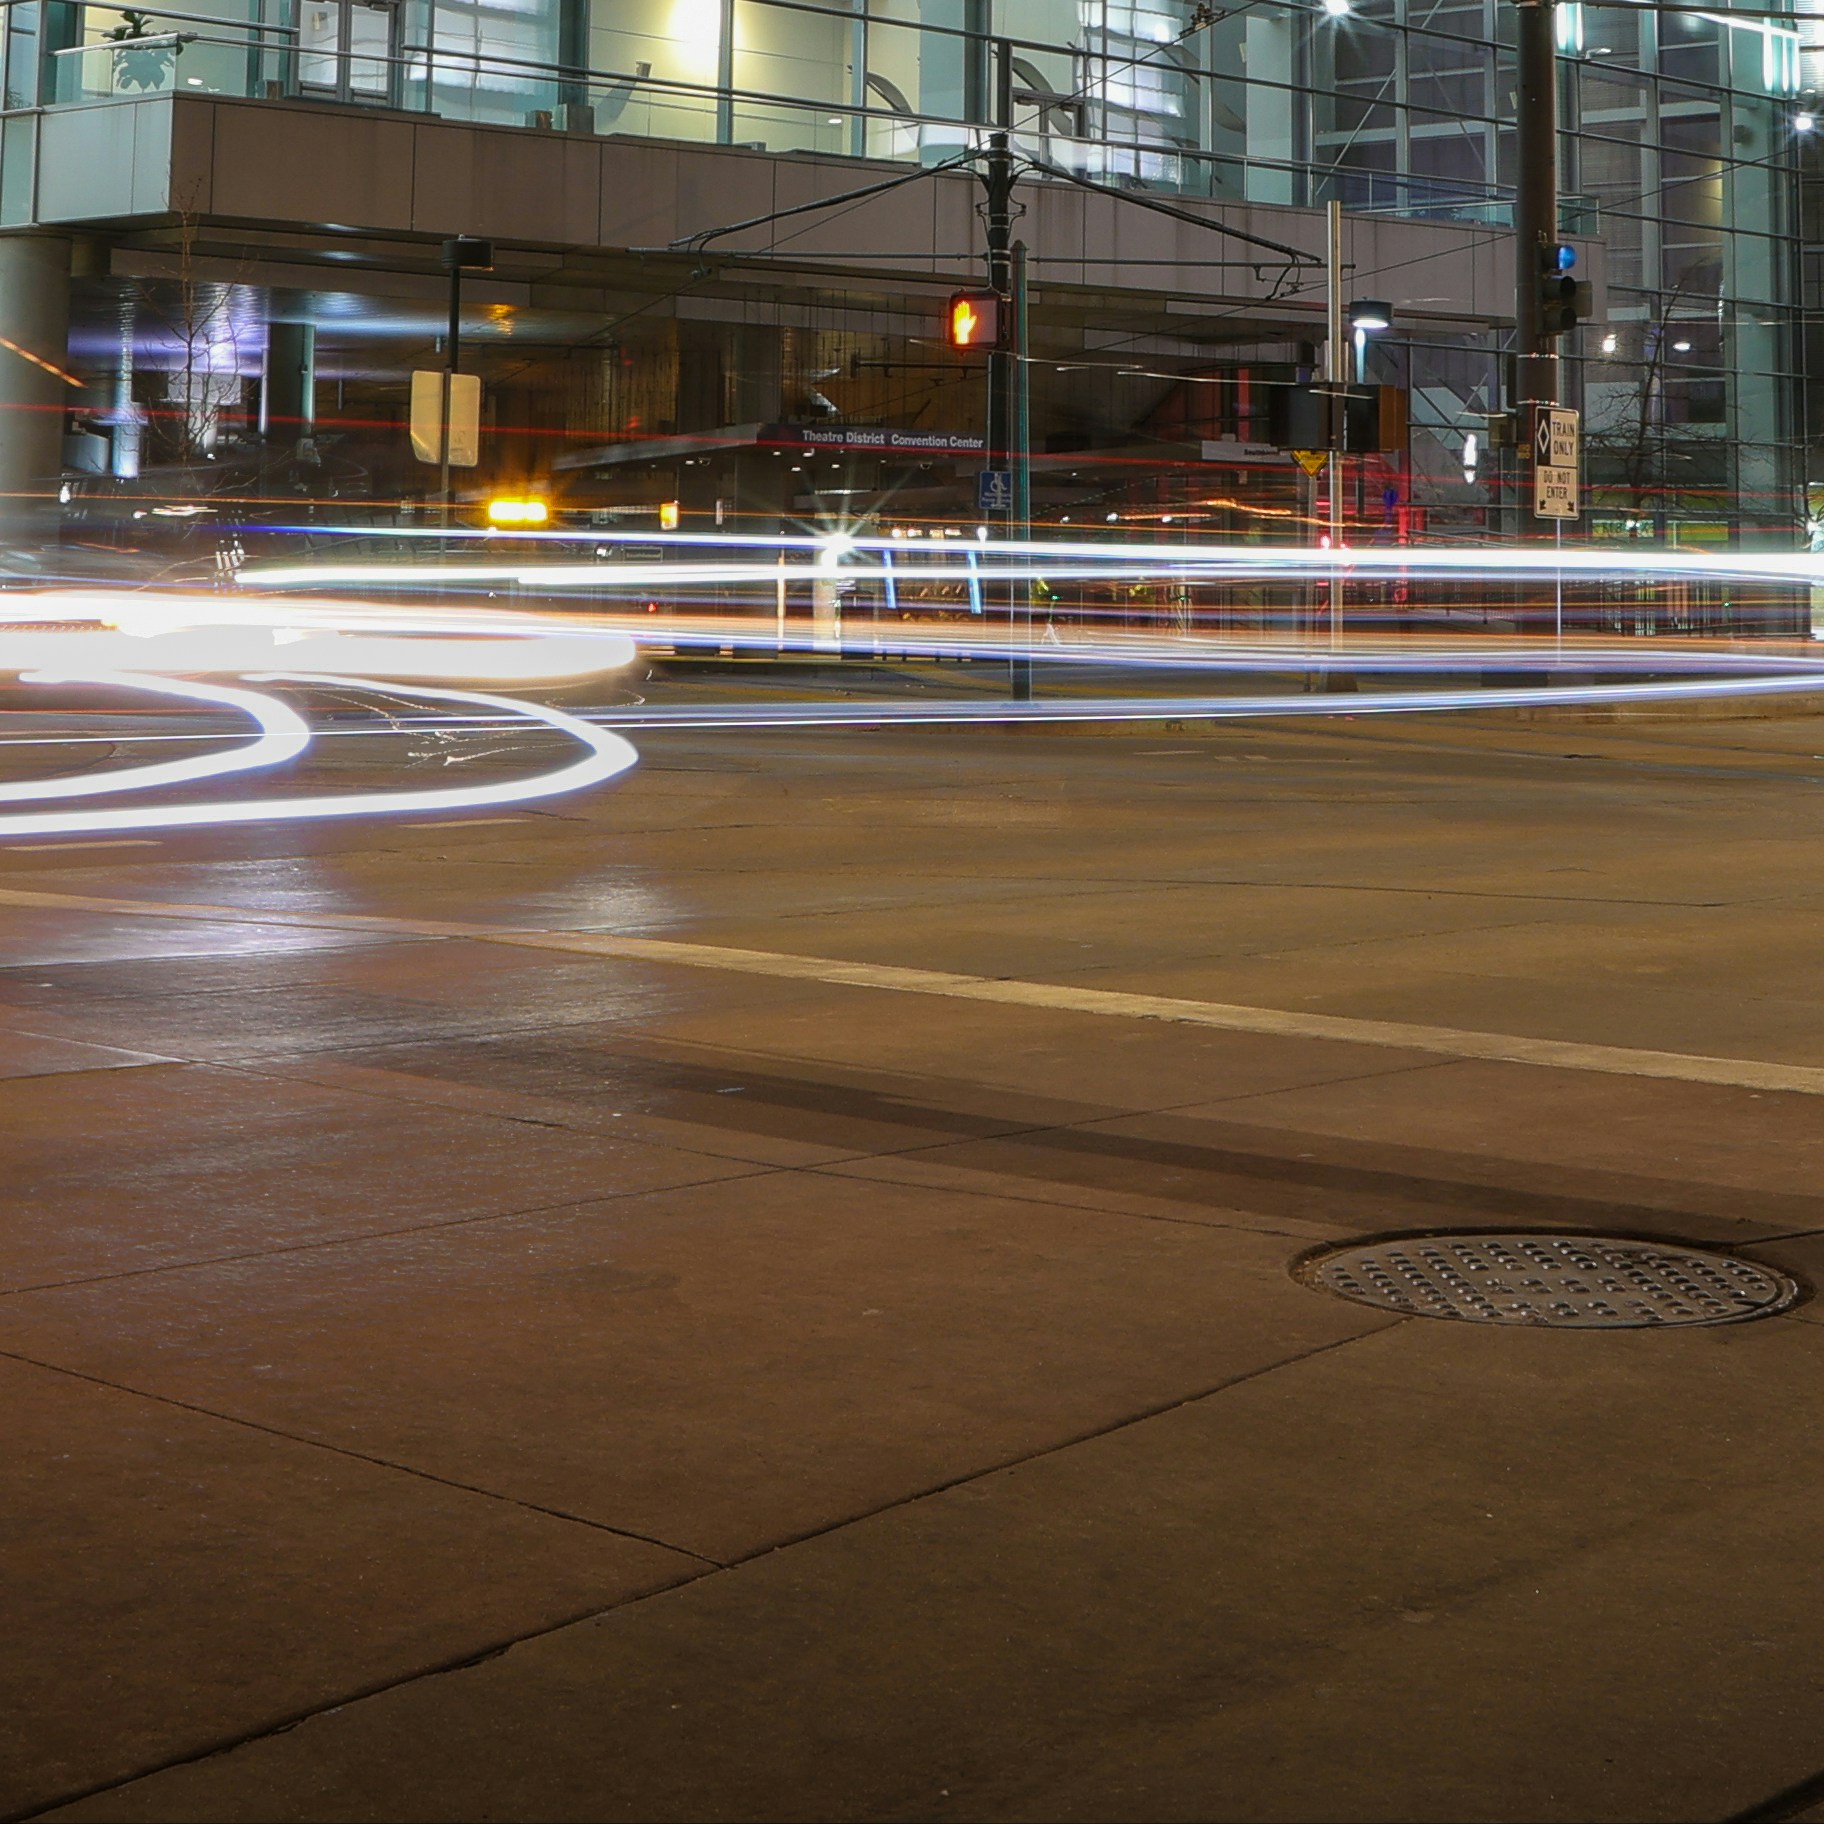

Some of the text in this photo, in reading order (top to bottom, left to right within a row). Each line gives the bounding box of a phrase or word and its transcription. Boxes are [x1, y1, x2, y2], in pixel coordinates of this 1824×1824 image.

[1552, 421, 1575, 437] TRAIN
[803, 430, 984, 449] Theatre District Convention Center
[1553, 440, 1575, 456] ONLY
[1543, 470, 1571, 485] DO NOT
[1546, 485, 1568, 499] ENTER
